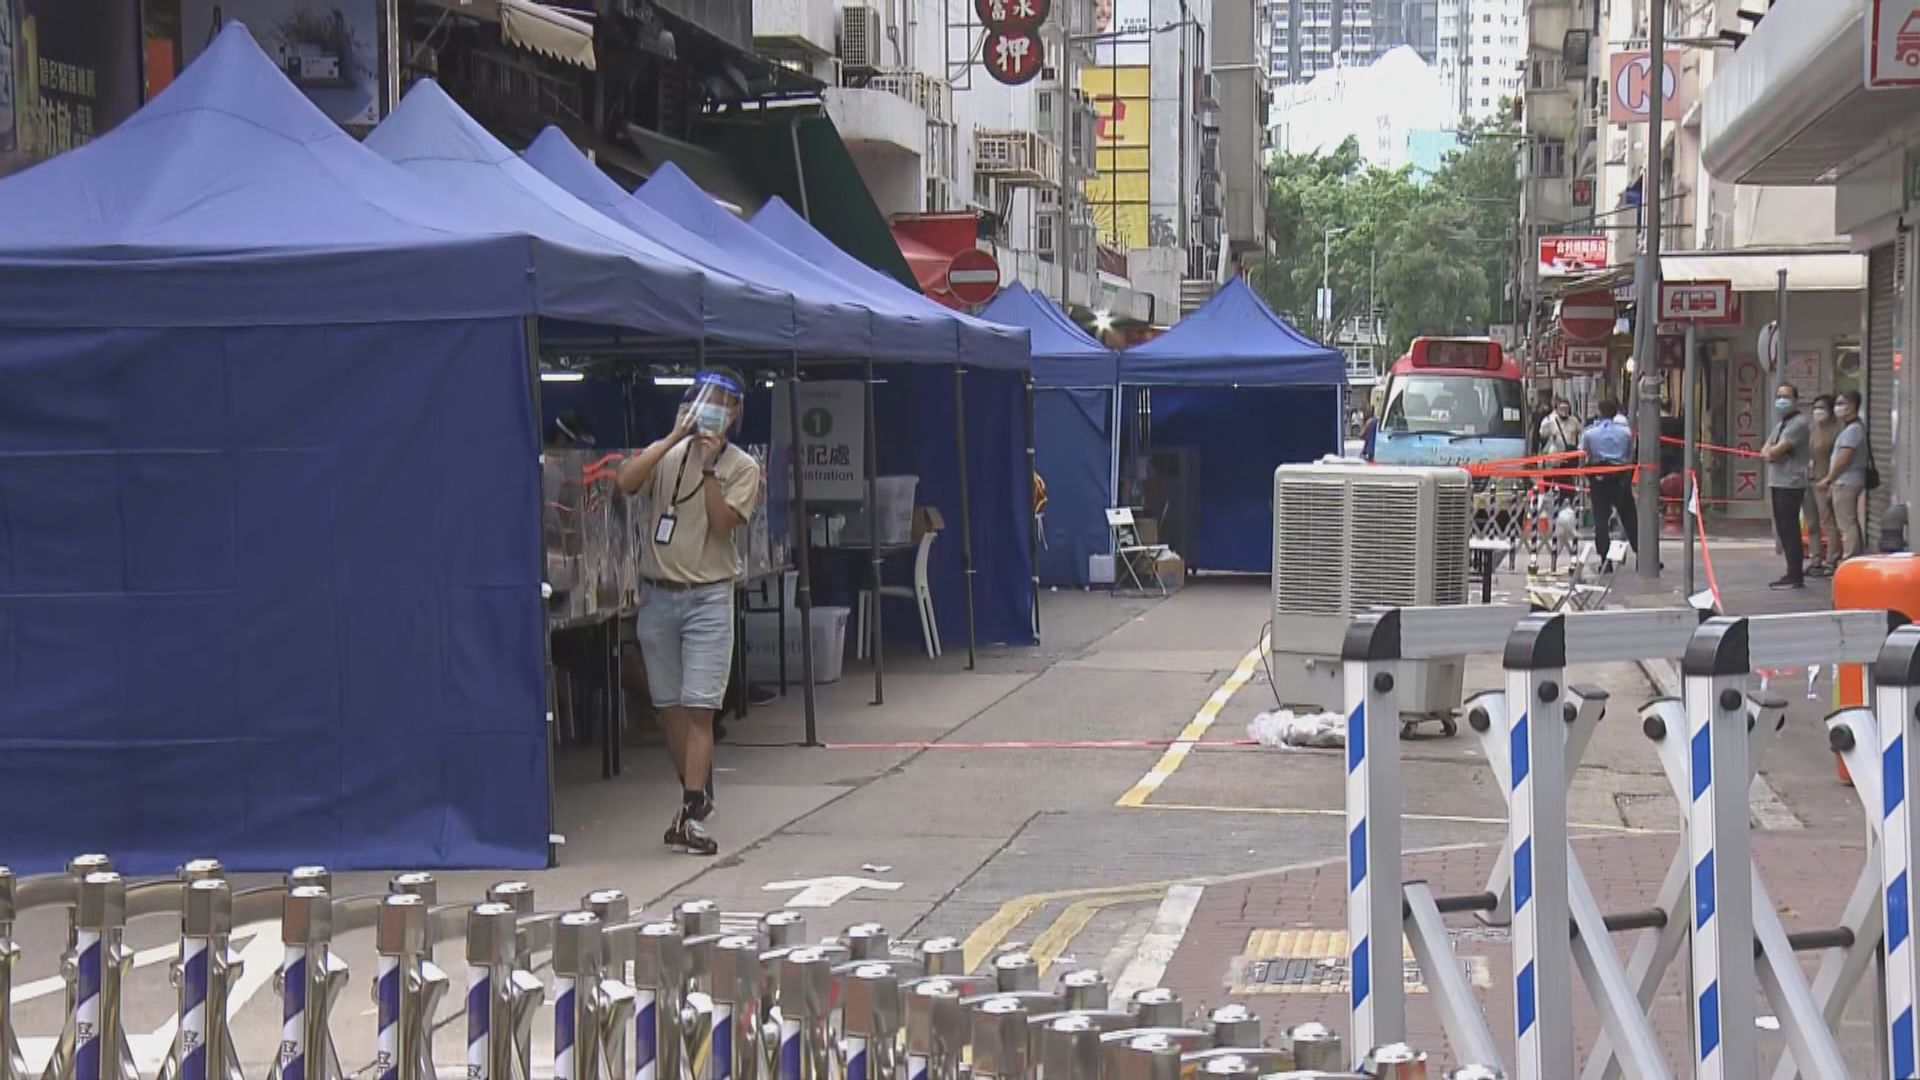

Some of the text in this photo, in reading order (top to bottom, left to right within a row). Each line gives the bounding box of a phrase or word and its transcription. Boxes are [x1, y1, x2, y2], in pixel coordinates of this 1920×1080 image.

[996, 36, 1030, 73] 押
[788, 443, 850, 466] 記處
[1736, 471, 1757, 492] K
